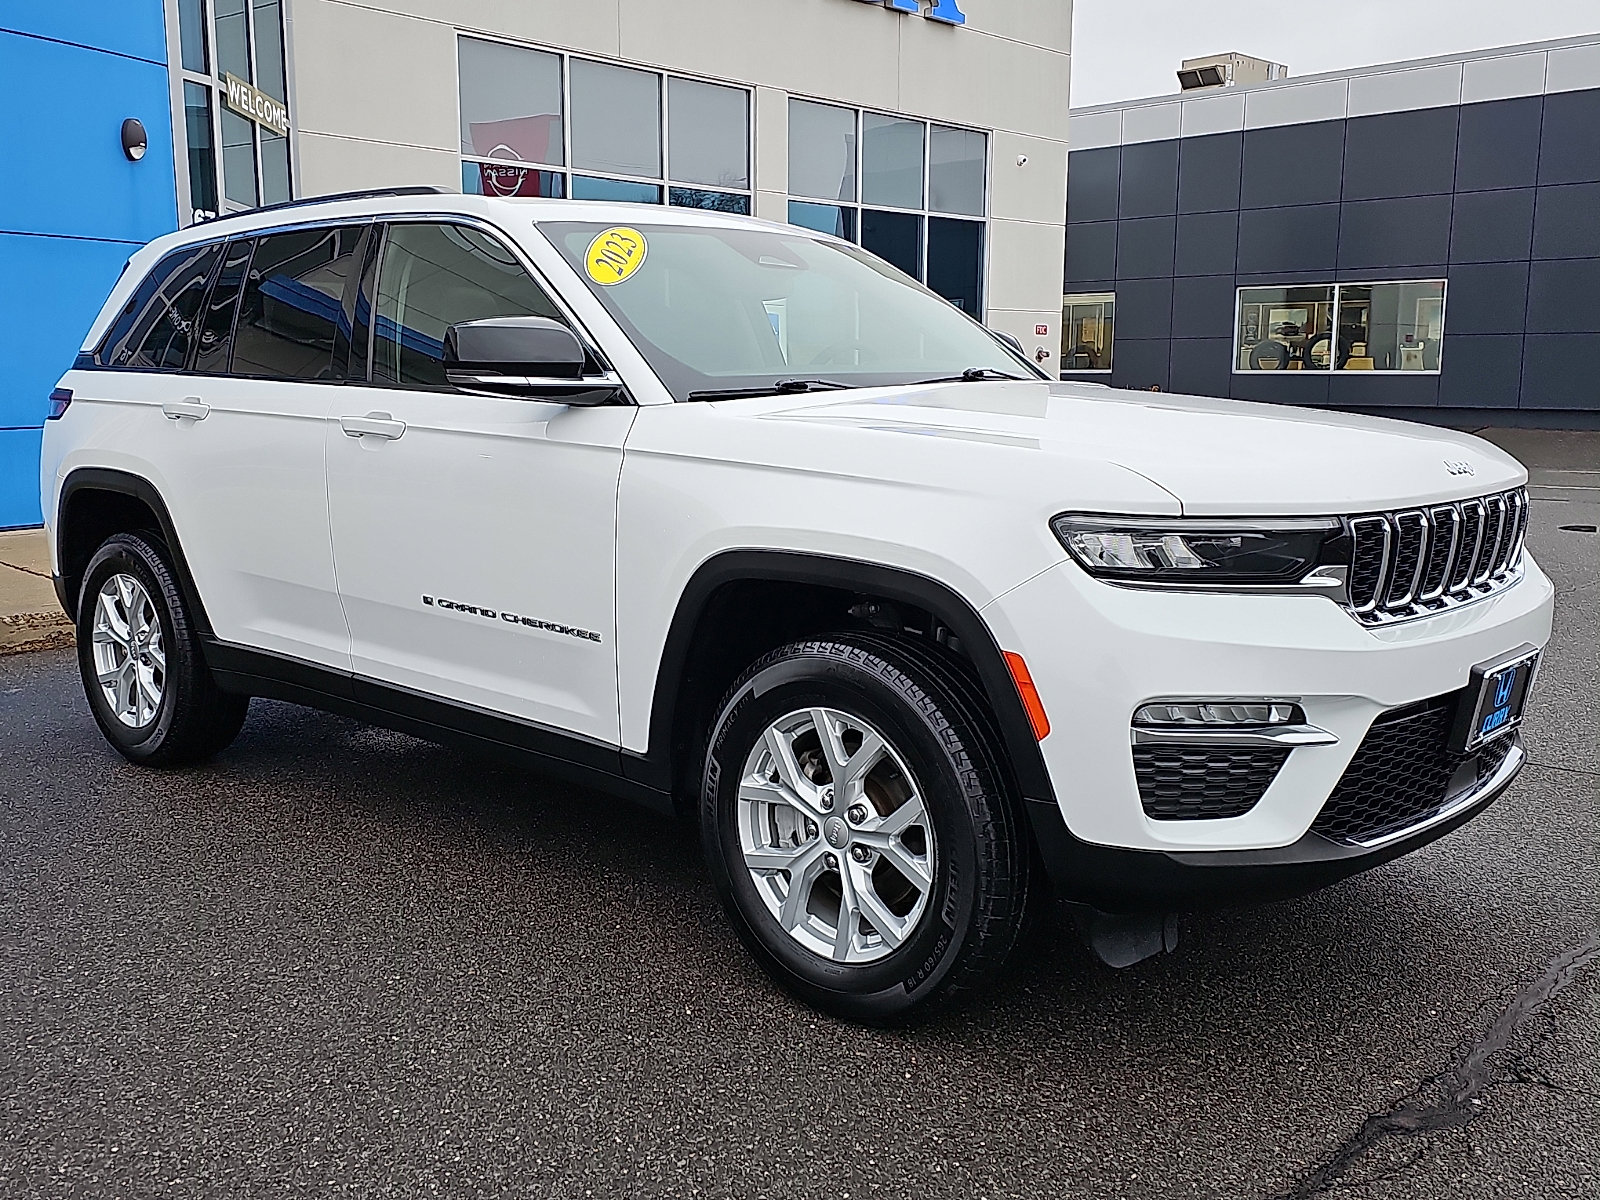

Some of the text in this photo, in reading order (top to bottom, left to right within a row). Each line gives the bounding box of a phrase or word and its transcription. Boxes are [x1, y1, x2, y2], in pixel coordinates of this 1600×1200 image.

[226, 77, 287, 132] WELCOME
[595, 232, 637, 276] 2023
[437, 599, 602, 644] GRAND CHEROKEE
[907, 976, 917, 988] 18
